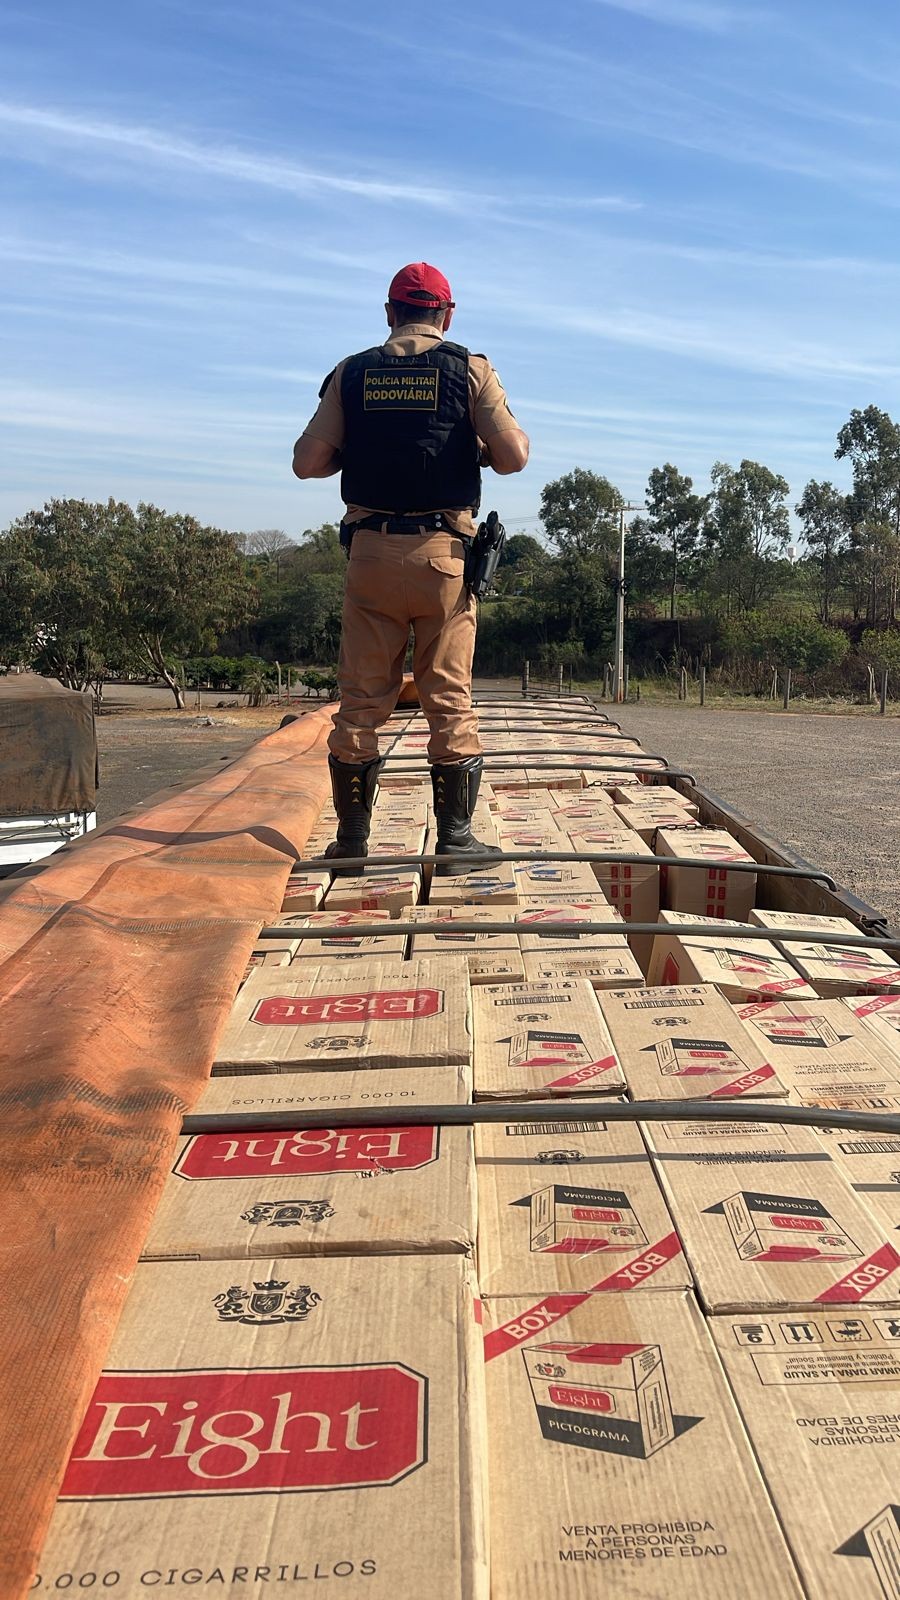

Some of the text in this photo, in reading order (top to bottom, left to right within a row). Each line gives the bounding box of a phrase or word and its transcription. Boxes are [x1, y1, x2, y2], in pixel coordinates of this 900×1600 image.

[366, 375, 436, 386] POLÍCIA MILITAR
[365, 387, 435, 401] RODOVIÁRIA
[274, 997, 420, 1019] Eight
[739, 1005, 766, 1019] BOX
[862, 1000, 887, 1010] BOX
[570, 1065, 604, 1082] BOX
[731, 1074, 766, 1090] BOX
[232, 1091, 416, 1106] 10.000 CIGARRILLOS
[213, 1129, 410, 1166] Eight
[564, 1191, 621, 1202] PICTOGRAMA
[754, 1199, 819, 1211] PICTOGRAMA
[617, 1252, 668, 1284] BOX
[840, 1264, 889, 1293] BOX
[502, 1305, 561, 1340] BOX
[821, 1369, 836, 1377] LA
[556, 1390, 604, 1408] Eight
[796, 1417, 838, 1427] EDAD
[841, 1416, 864, 1425] DE
[71, 1391, 379, 1479] Eight
[549, 1420, 630, 1443] PICTOGRAMA
[809, 1435, 895, 1446] PROHIBIDA
[562, 1521, 715, 1537] VENTA PROHIBIDA
[586, 1534, 697, 1548] A PERSONAS
[559, 1544, 728, 1561] MENORES DE EDAD
[140, 1560, 377, 1586] CIGARRILLOS
